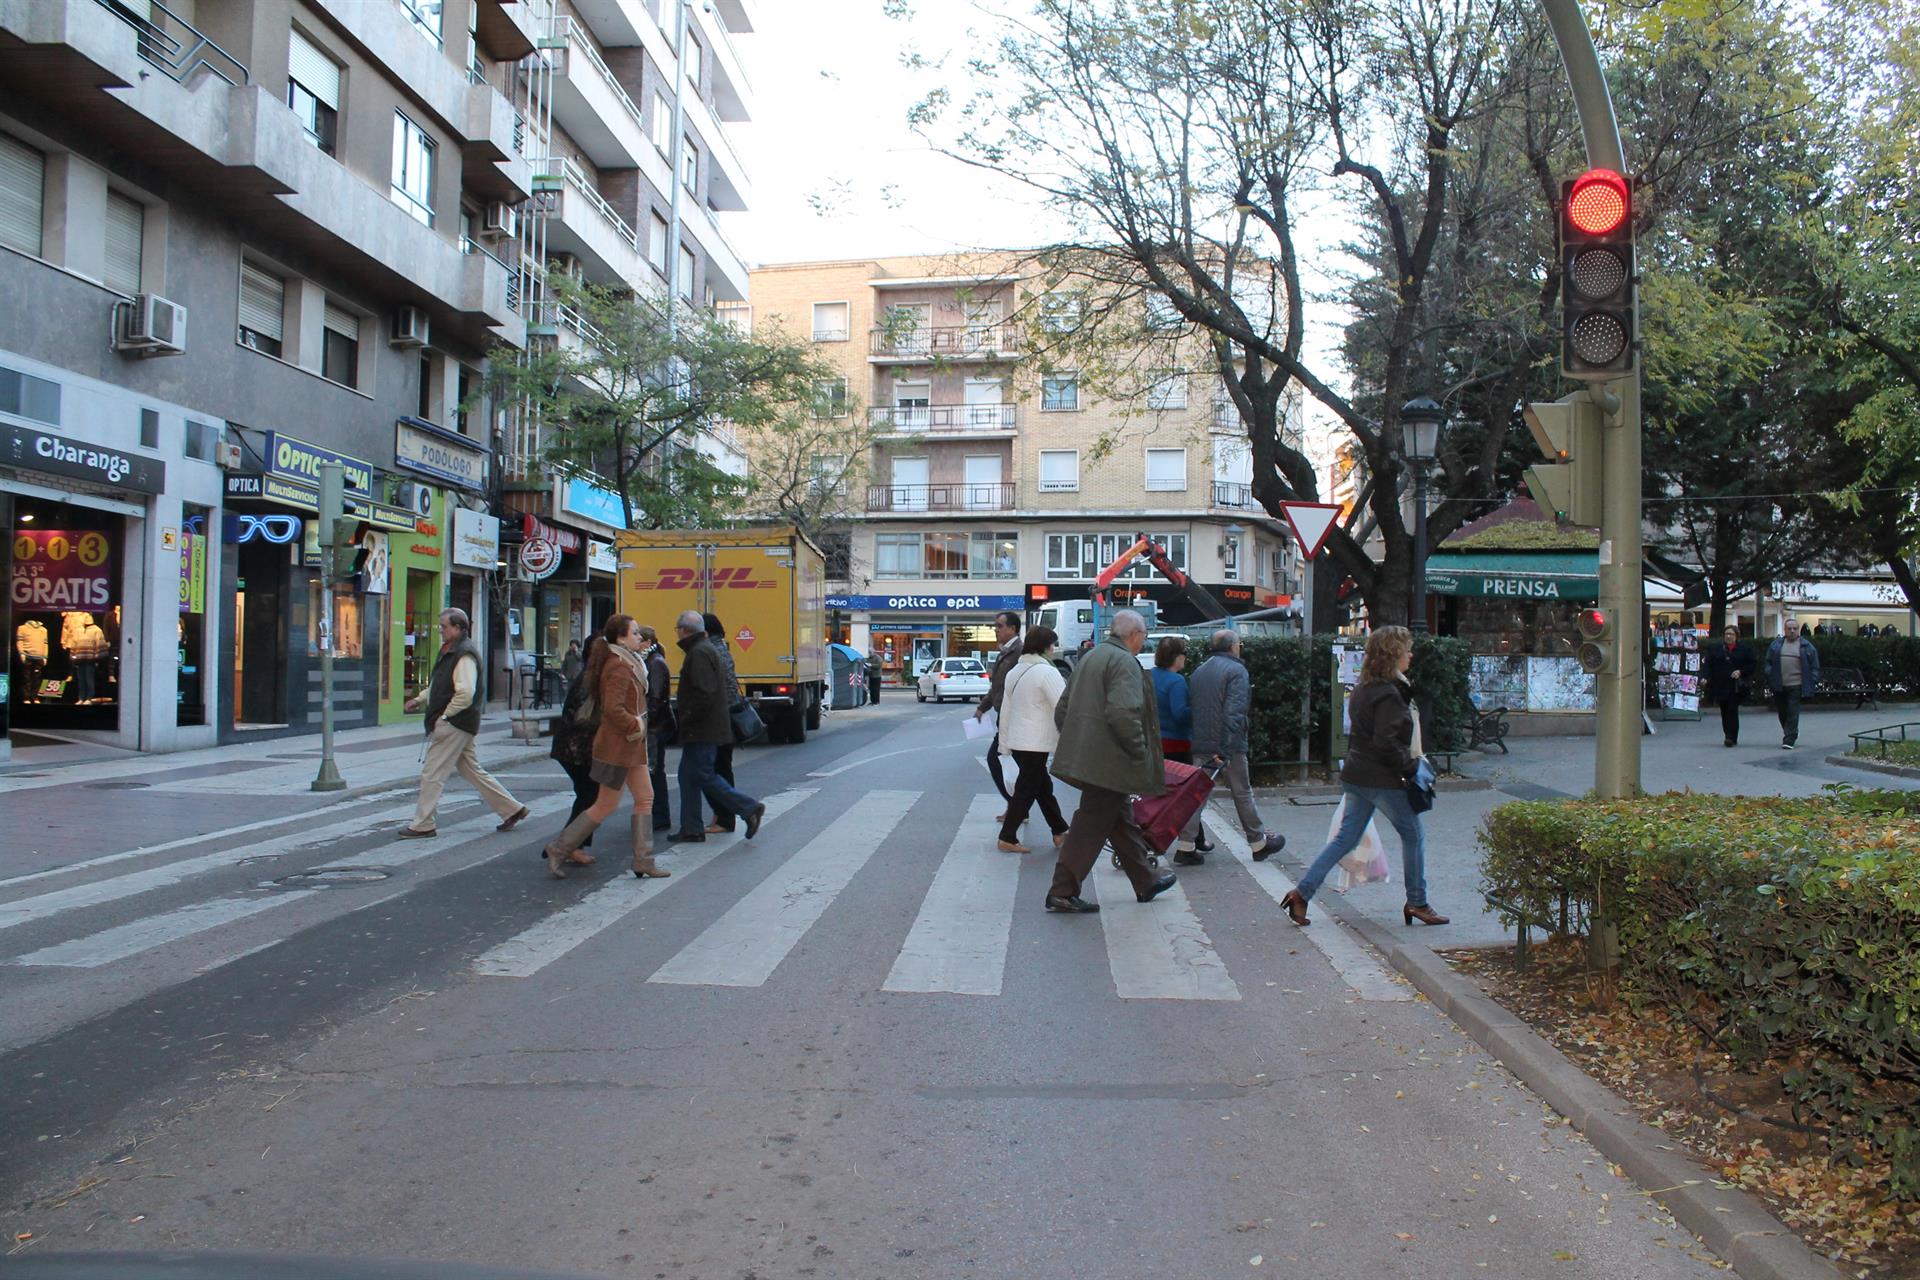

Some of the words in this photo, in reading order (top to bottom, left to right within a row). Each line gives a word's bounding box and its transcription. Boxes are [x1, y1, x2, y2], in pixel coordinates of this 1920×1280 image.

[36, 436, 130, 482] Charanga
[277, 442, 329, 478] OPTIC
[422, 444, 472, 476] PODÓLOGO
[228, 478, 260, 493] OPTICA
[83, 536, 101, 562] 3
[13, 566, 27, 577] LA
[656, 567, 758, 590] DHL
[11, 577, 110, 605] GRATIS
[1483, 578, 1559, 598] PRENSA
[888, 596, 937, 610] optica
[946, 596, 980, 610] epat
